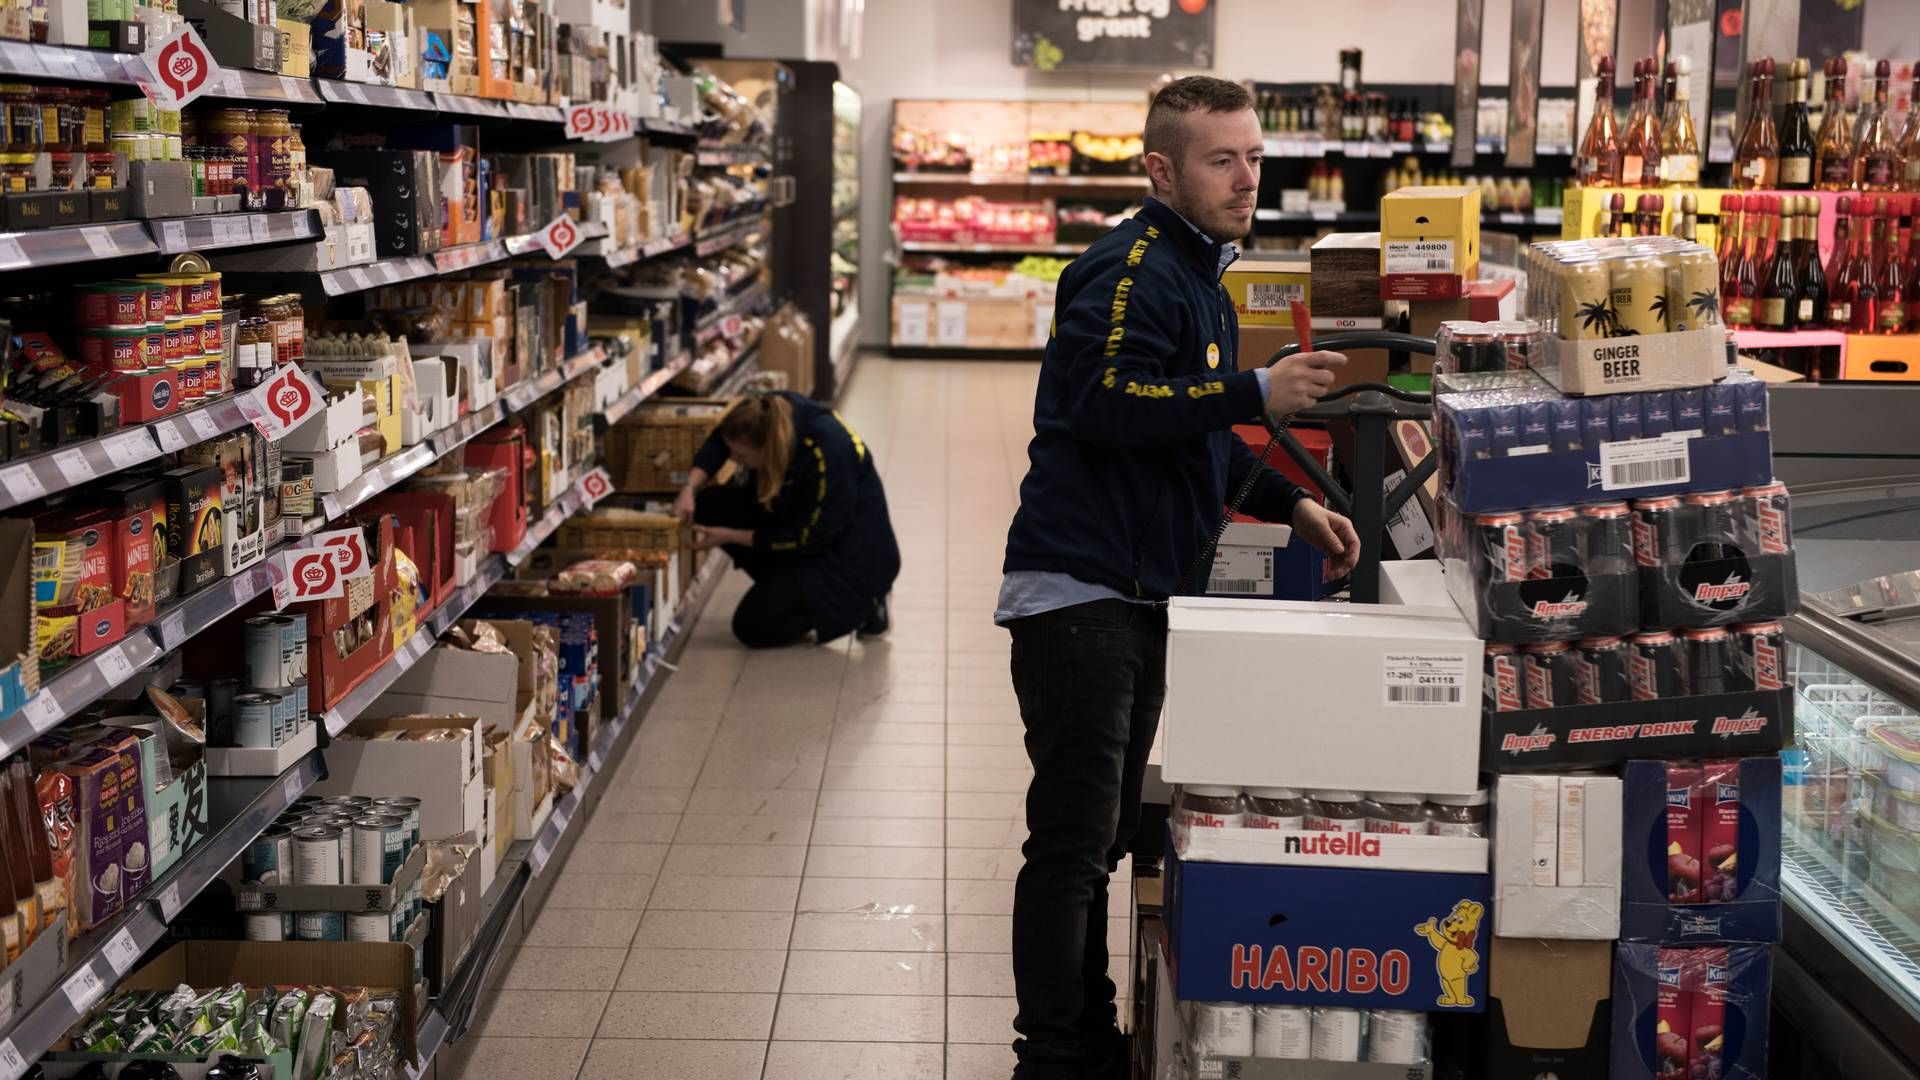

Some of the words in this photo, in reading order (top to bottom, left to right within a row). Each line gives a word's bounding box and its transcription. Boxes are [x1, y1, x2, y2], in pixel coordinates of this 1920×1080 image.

[1076, 15, 1151, 42] grønt
[118, 303, 136, 313] DIP
[166, 338, 179, 347] DIP
[204, 331, 216, 339] DIP
[114, 349, 132, 358] DIP
[147, 346, 160, 355] DIP
[1593, 345, 1640, 361] GINGER
[1603, 360, 1641, 378] BEER
[187, 379, 200, 387] DIP
[127, 547, 142, 569] MINI
[1695, 582, 1750, 601] Amper
[1532, 600, 1588, 619] Amper
[1568, 724, 1640, 743] ENERGY
[1639, 720, 1698, 738] DRINK
[1710, 716, 1767, 735] Amper
[1501, 734, 1556, 752] Amper
[1284, 832, 1380, 857] nutella
[1231, 944, 1410, 995] HARIBO
